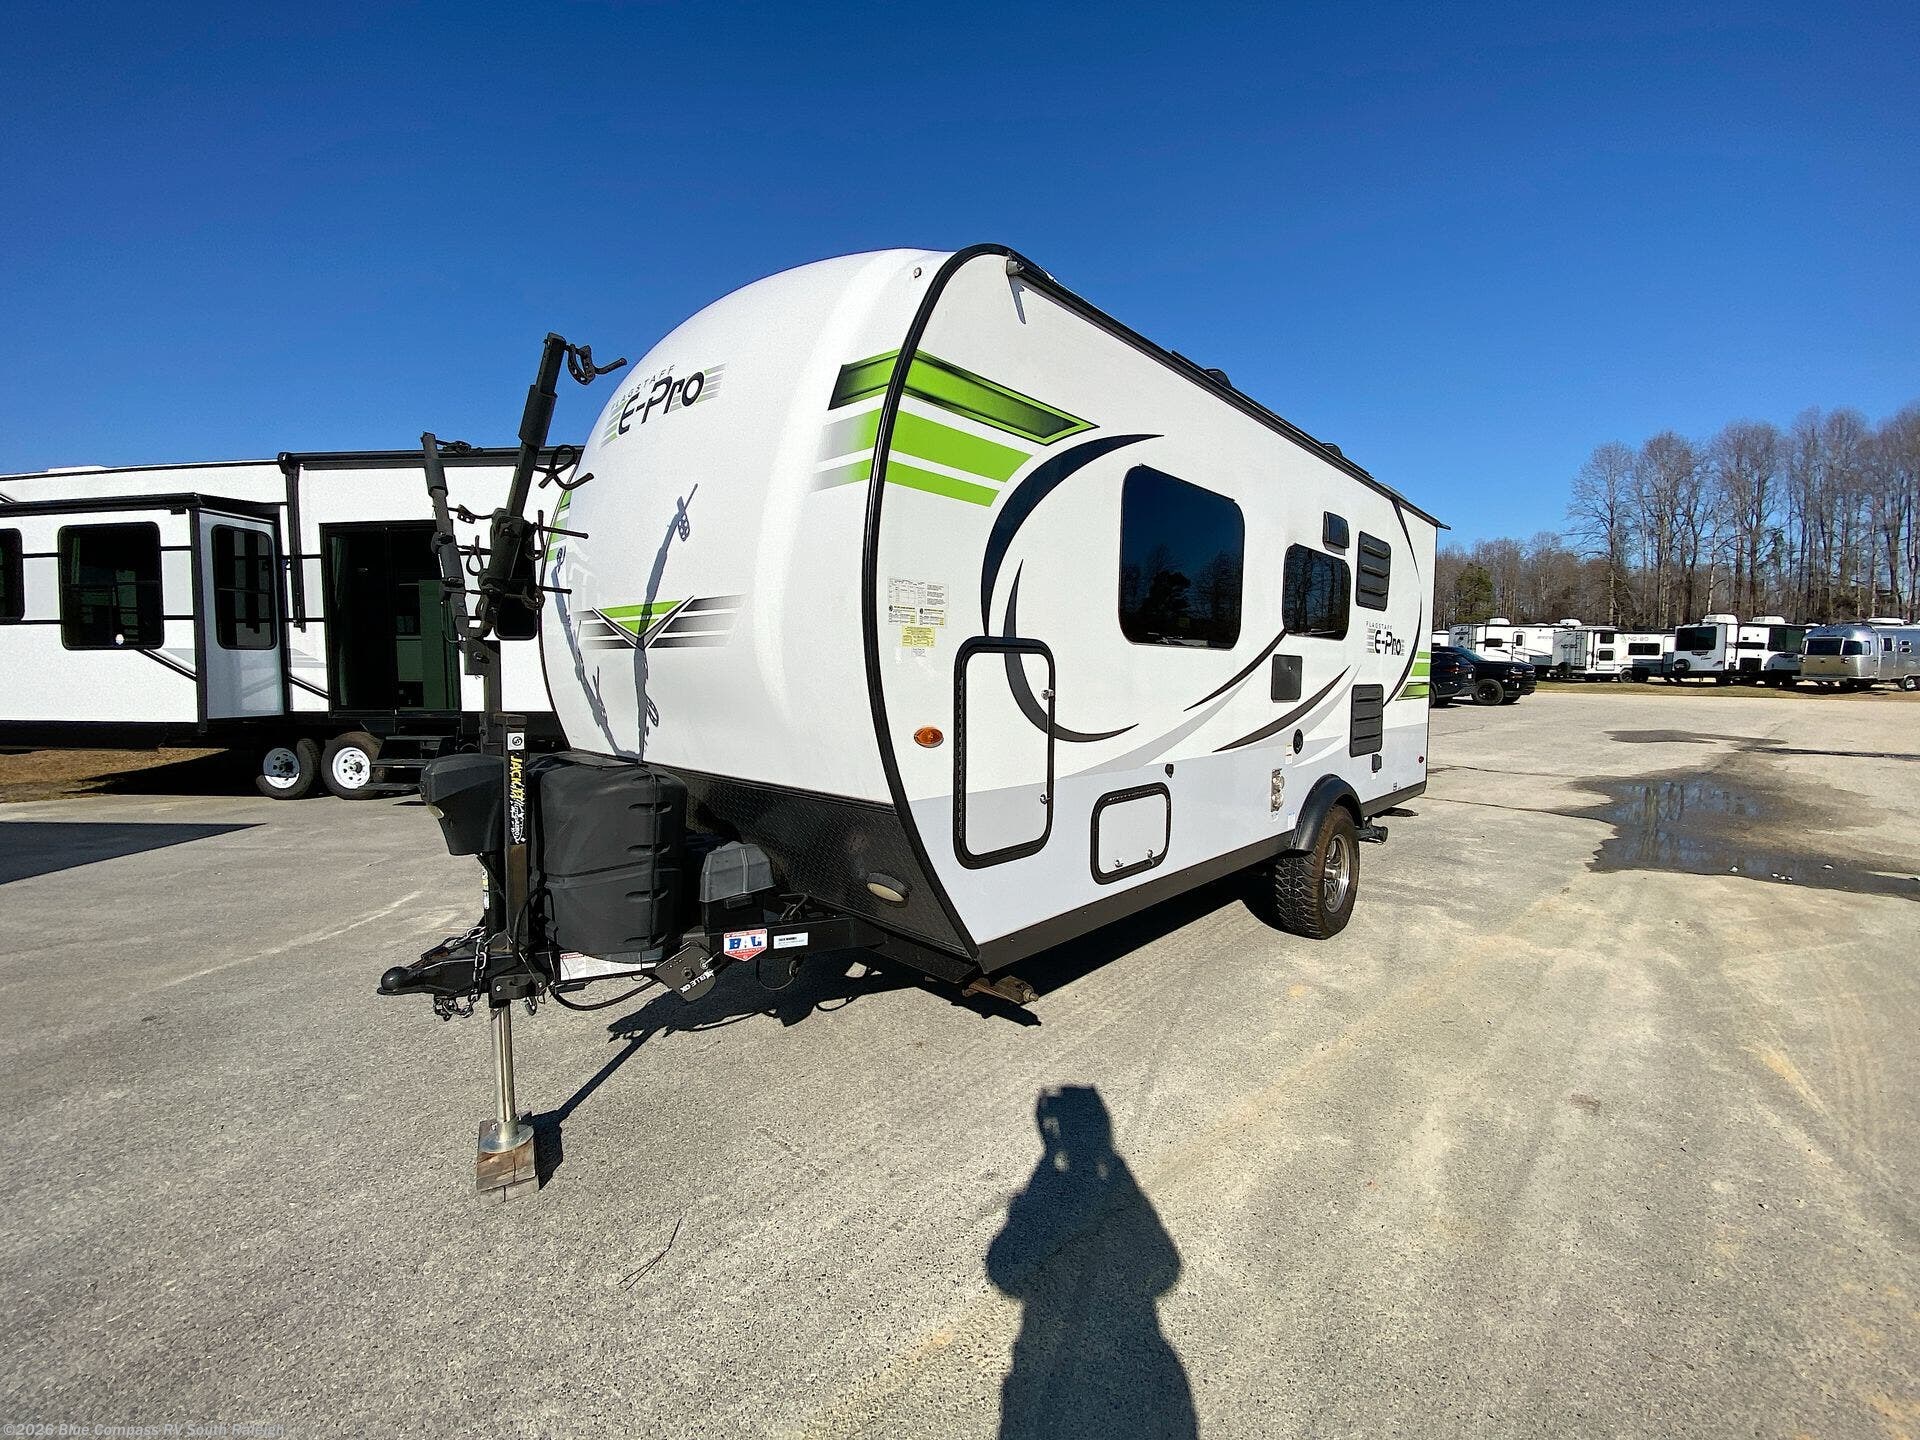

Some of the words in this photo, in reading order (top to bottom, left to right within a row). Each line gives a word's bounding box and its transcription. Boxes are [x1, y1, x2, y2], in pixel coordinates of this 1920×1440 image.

[618, 371, 705, 435] E-Pro
[1366, 620, 1393, 630] FLAGSTAFF
[1374, 629, 1402, 656] E-Pro
